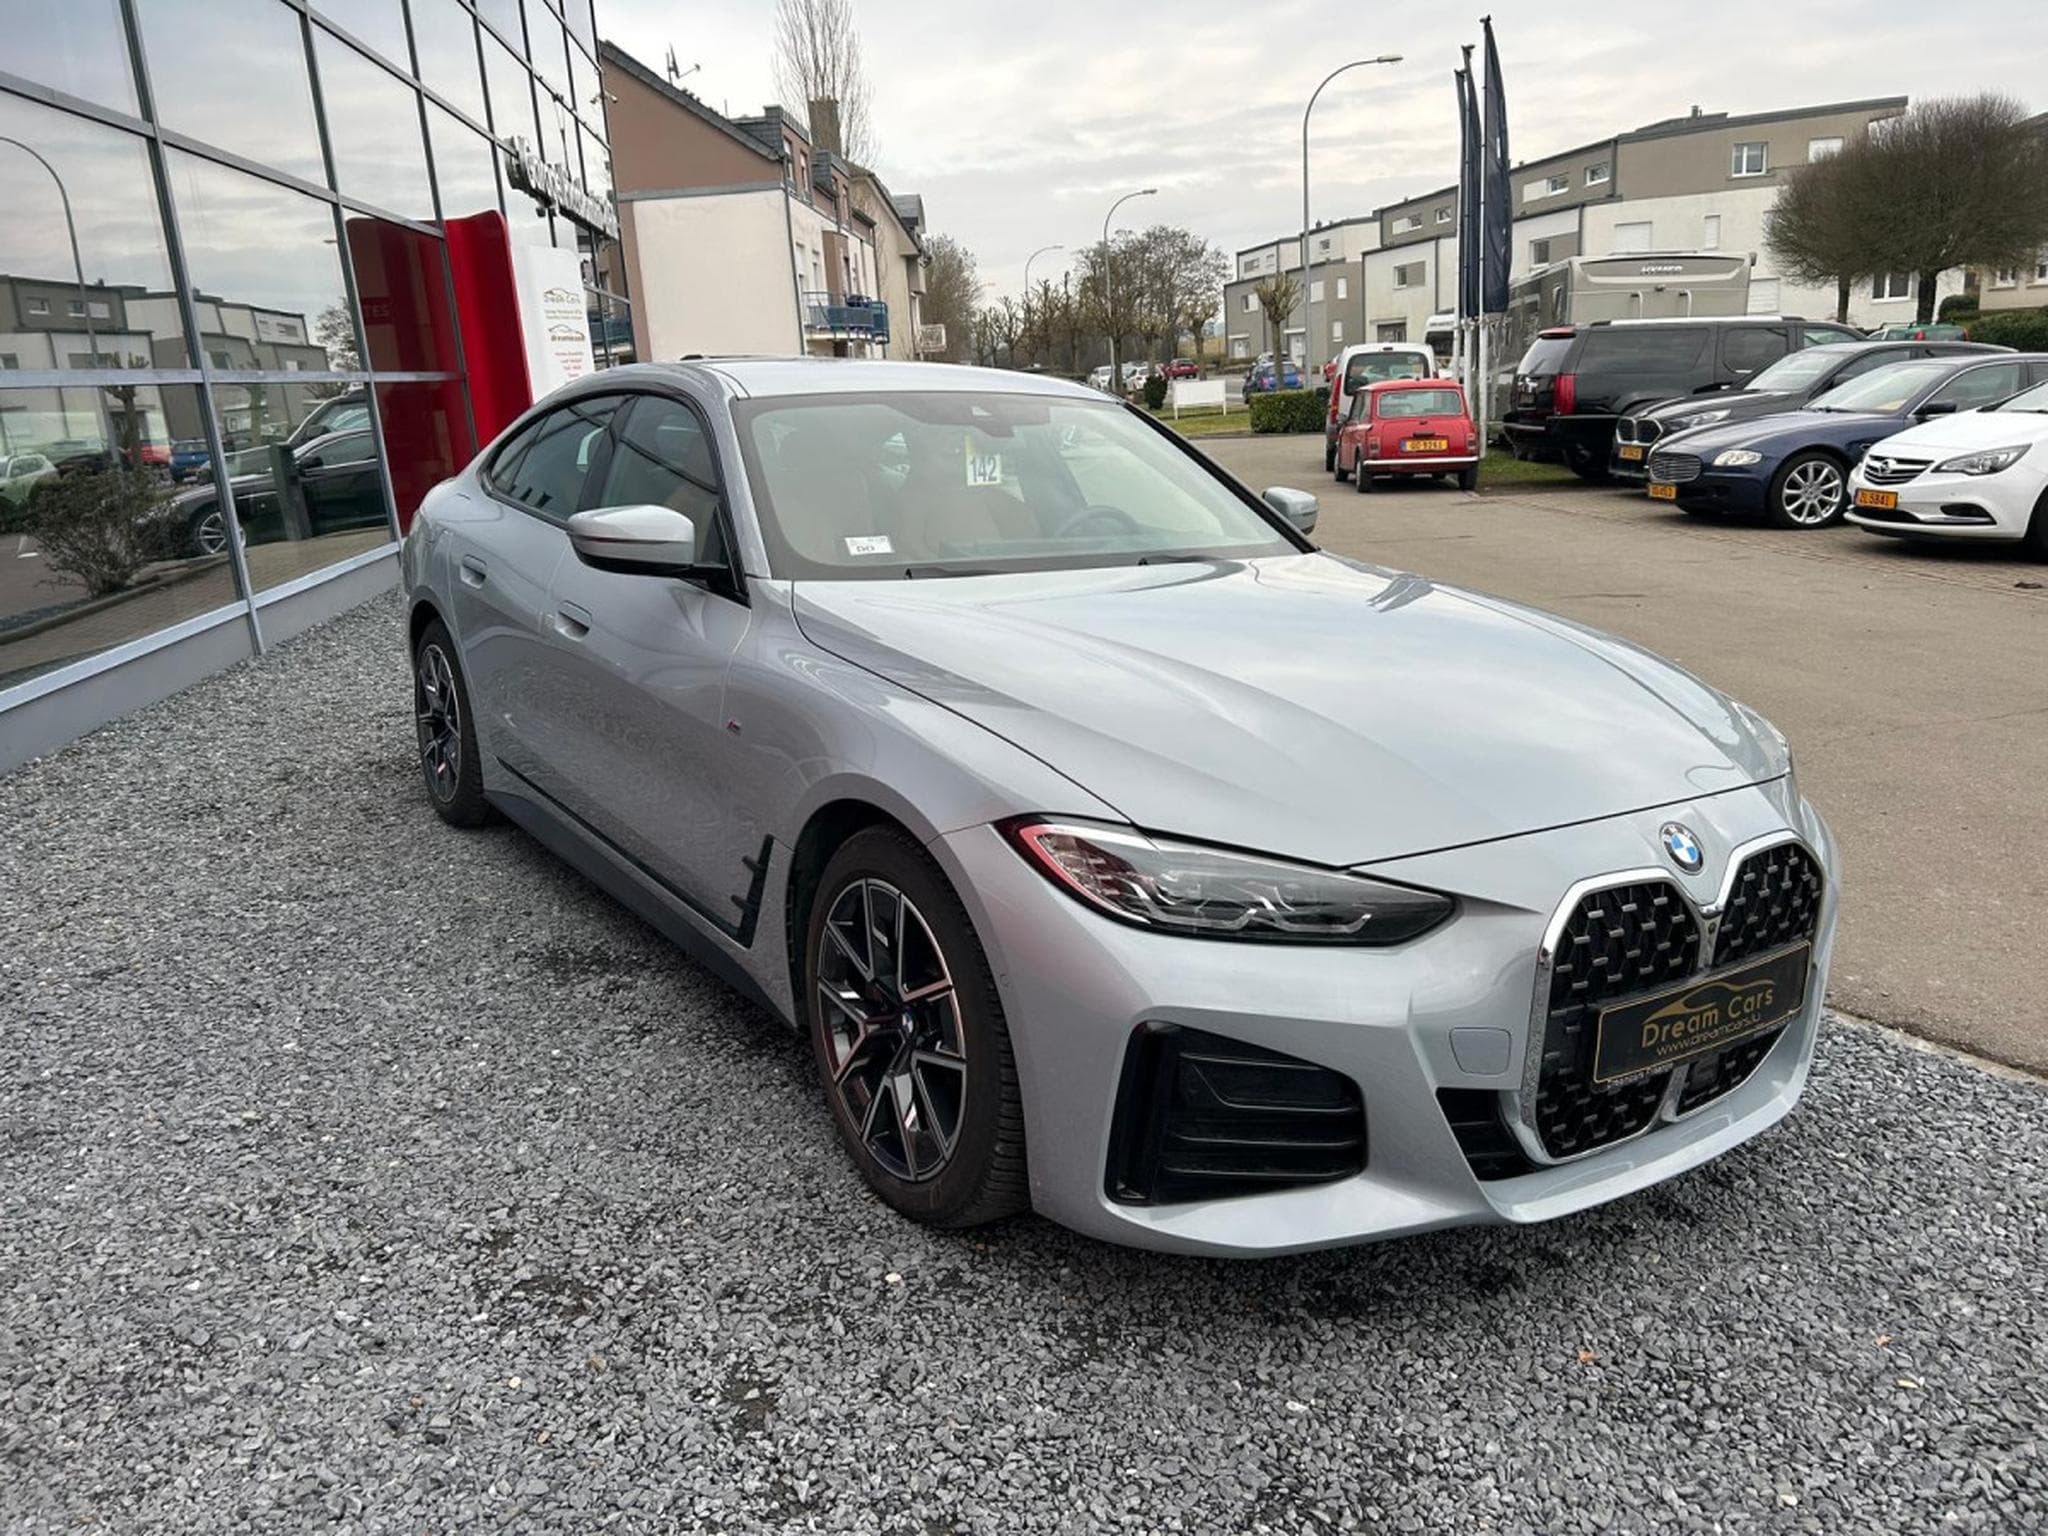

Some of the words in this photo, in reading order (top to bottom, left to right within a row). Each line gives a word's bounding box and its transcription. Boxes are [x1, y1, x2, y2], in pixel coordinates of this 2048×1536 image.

[970, 456, 998, 483] 142
[1641, 1009, 1719, 1048] Dream
[1727, 988, 1774, 1019] Cars
